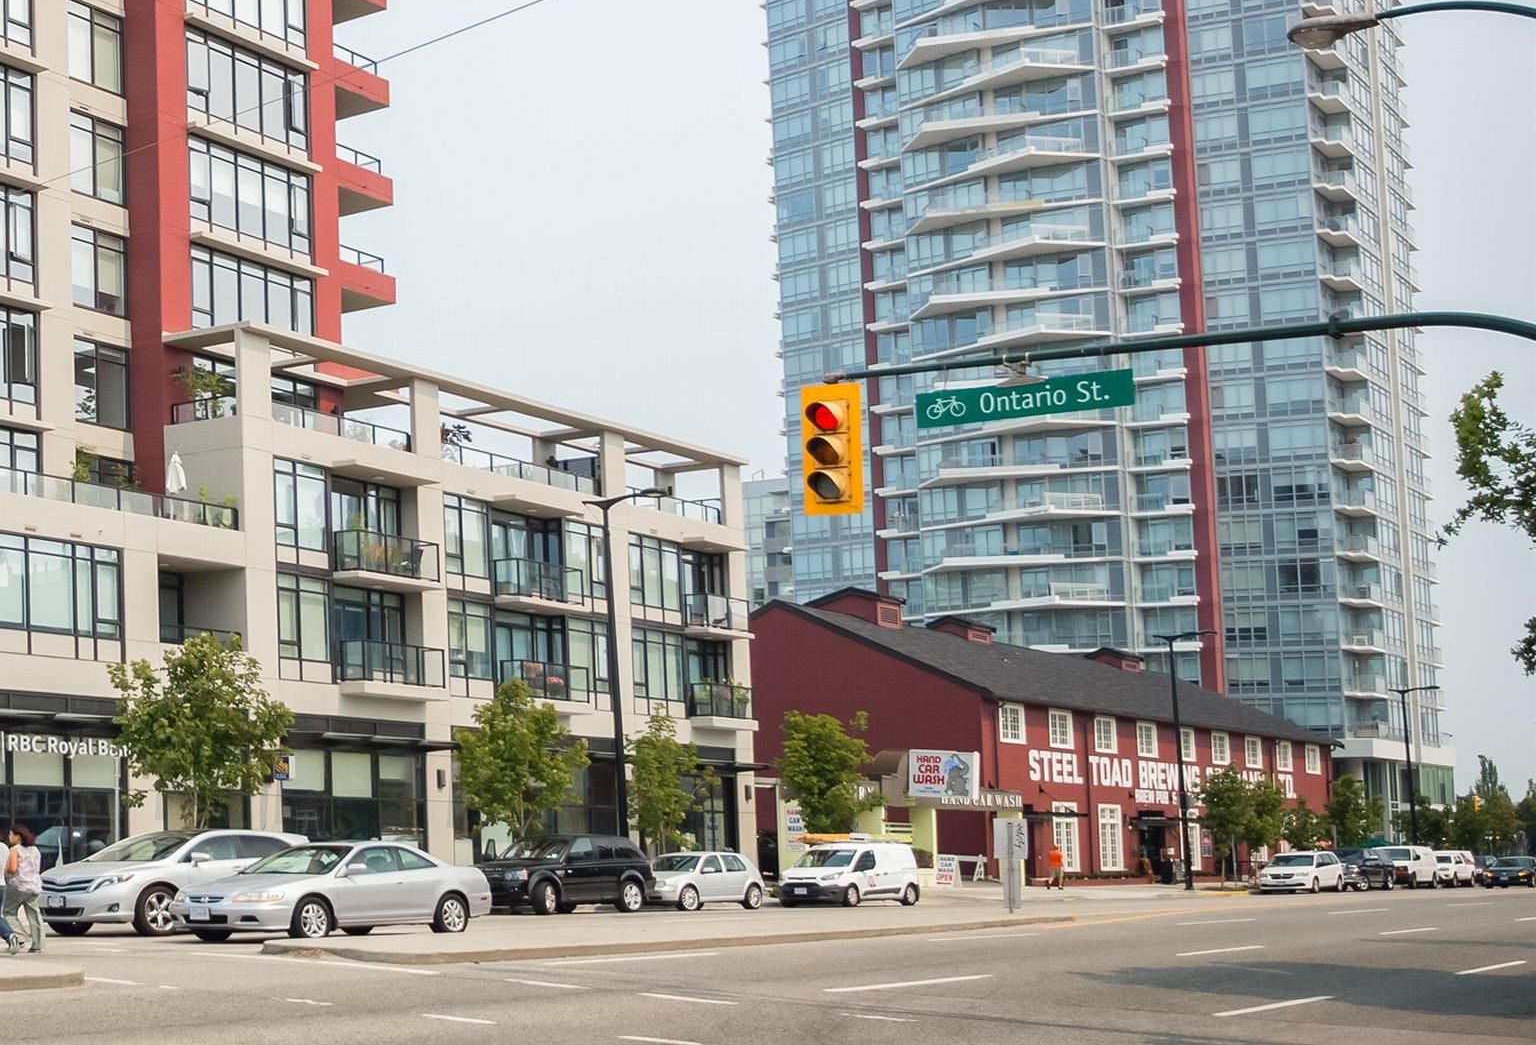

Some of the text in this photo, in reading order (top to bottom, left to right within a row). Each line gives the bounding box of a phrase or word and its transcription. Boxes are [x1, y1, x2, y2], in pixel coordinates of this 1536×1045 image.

[979, 380, 1110, 414] Ontario St.
[7, 734, 47, 753] RBC
[48, 737, 93, 759] Royal
[916, 755, 942, 764] HAND
[918, 764, 940, 774] CAR
[1028, 749, 1084, 785] STEEL
[1088, 755, 1133, 788] TOAD
[1138, 760, 1201, 793] BREWNG
[913, 774, 944, 785] WASH
[972, 794, 993, 807] CAR
[995, 795, 1022, 808] WASH
